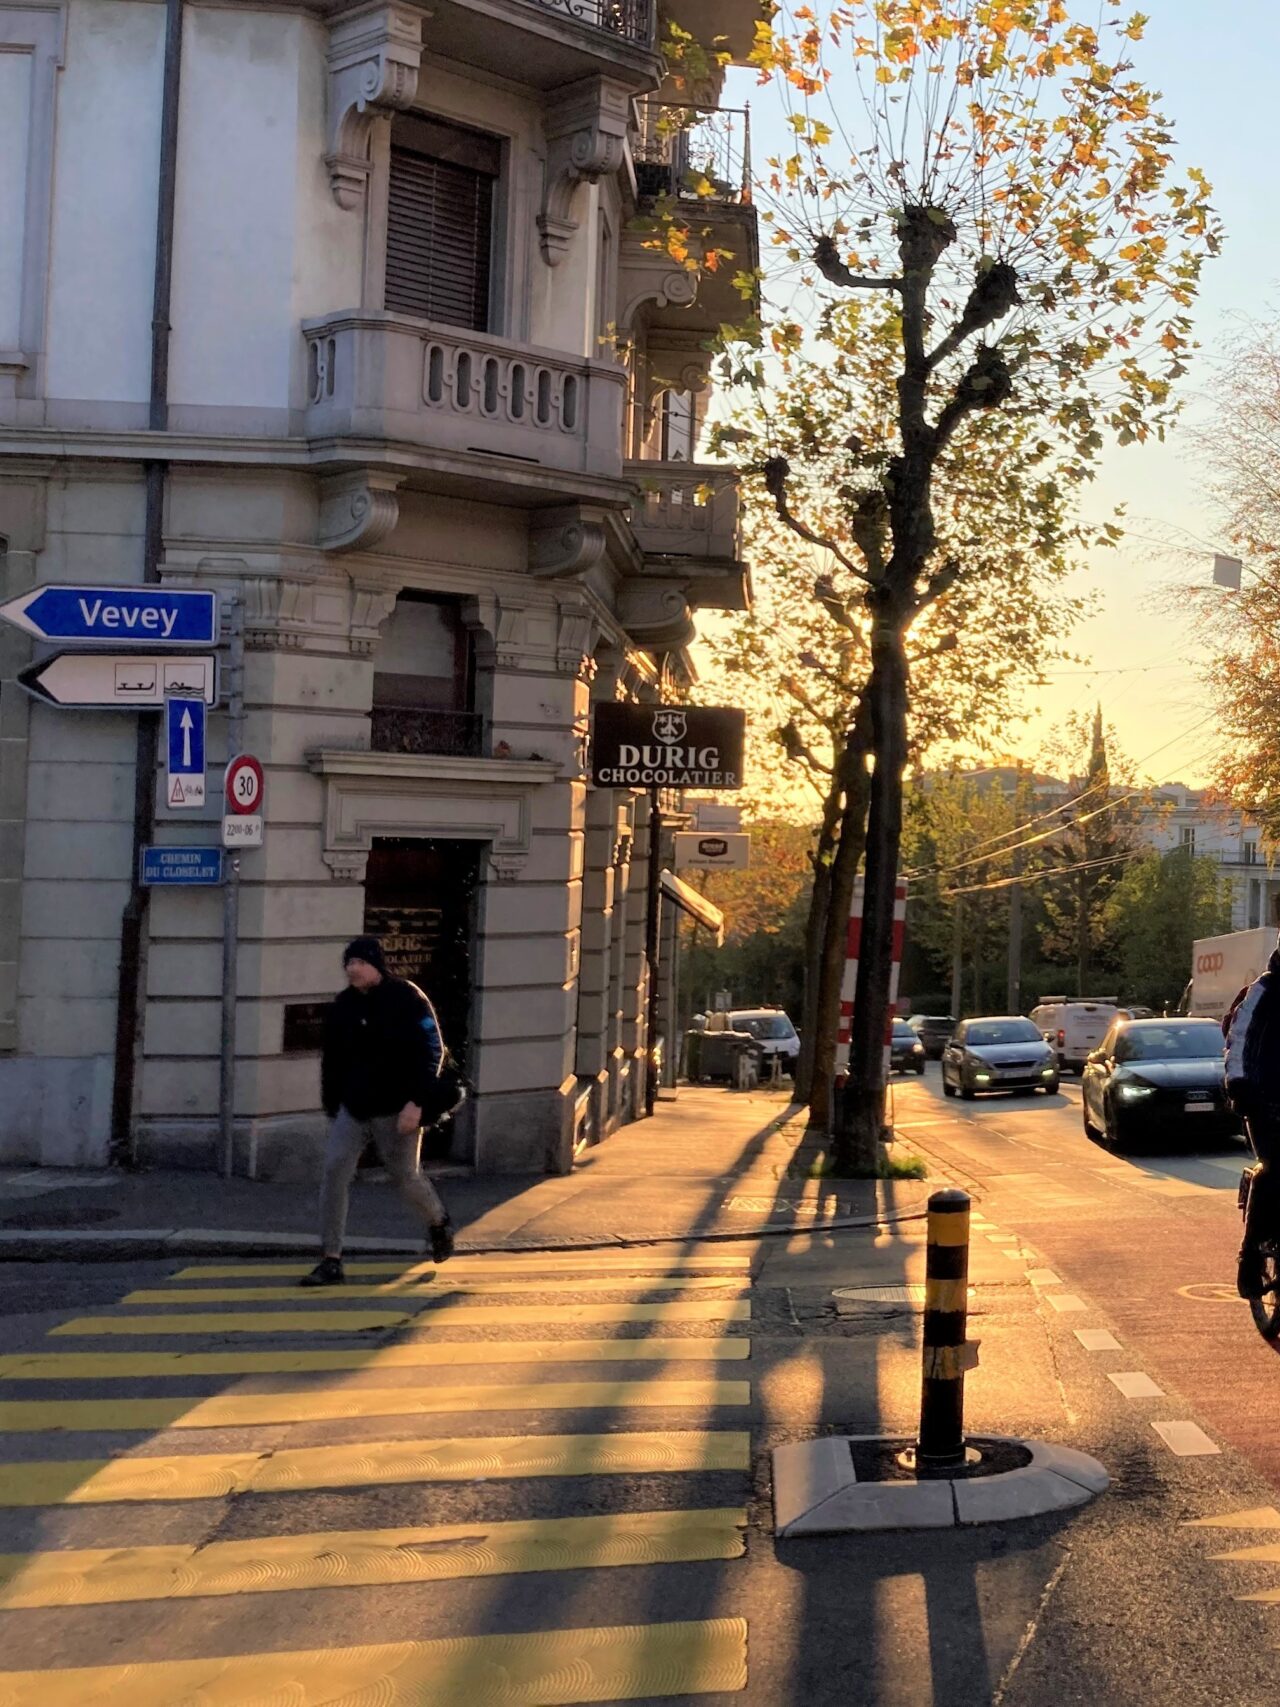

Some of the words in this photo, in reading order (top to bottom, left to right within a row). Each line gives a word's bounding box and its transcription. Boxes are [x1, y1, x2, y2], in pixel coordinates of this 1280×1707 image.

[79, 599, 179, 637] Vevey
[619, 745, 720, 769] DURIG
[238, 776, 254, 797] 30
[598, 768, 737, 785] CHOCOLATIER
[160, 853, 202, 865] CHEMIN
[145, 866, 160, 878] DU
[1197, 953, 1224, 976] coop
